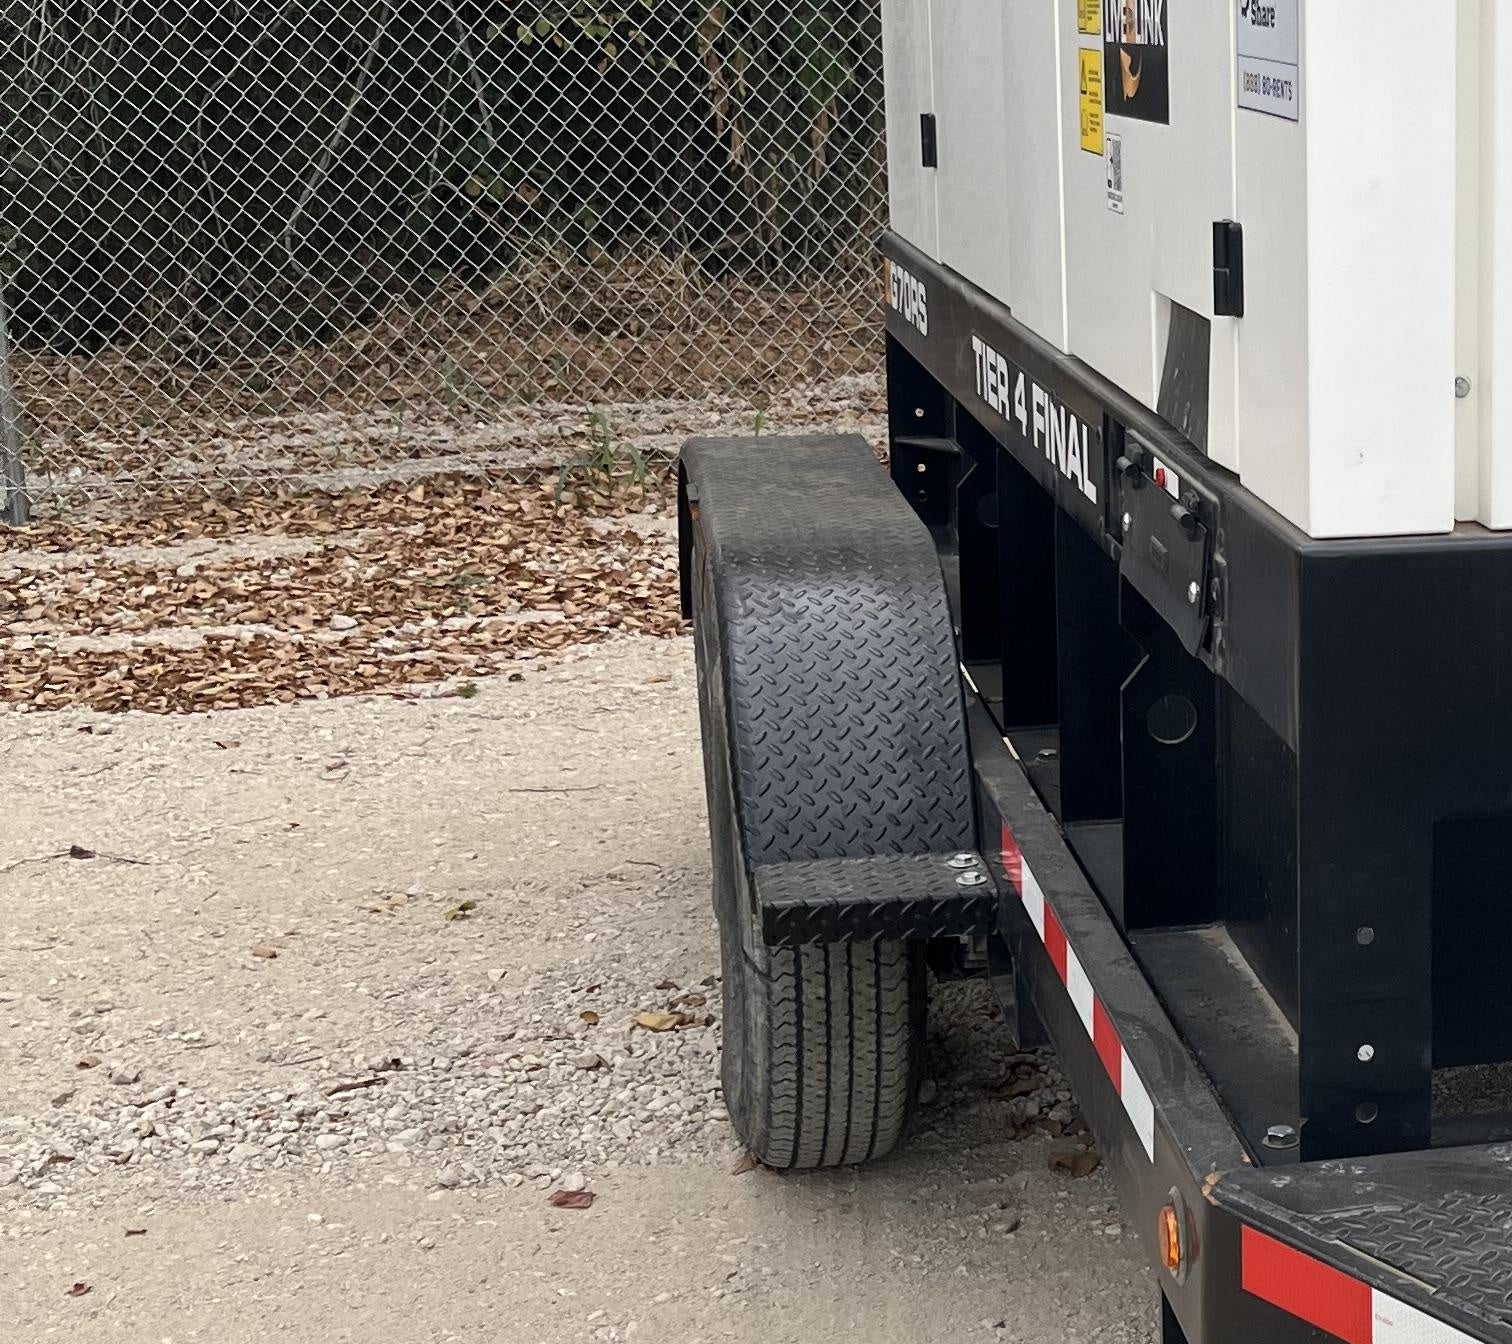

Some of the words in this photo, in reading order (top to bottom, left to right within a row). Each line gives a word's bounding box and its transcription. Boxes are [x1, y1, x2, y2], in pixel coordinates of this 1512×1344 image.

[1251, 0, 1276, 29] Share
[890, 260, 928, 337] G70RS
[972, 335, 1010, 421] TIER
[1014, 371, 1028, 438] 4
[1032, 381, 1097, 504] FINAL
